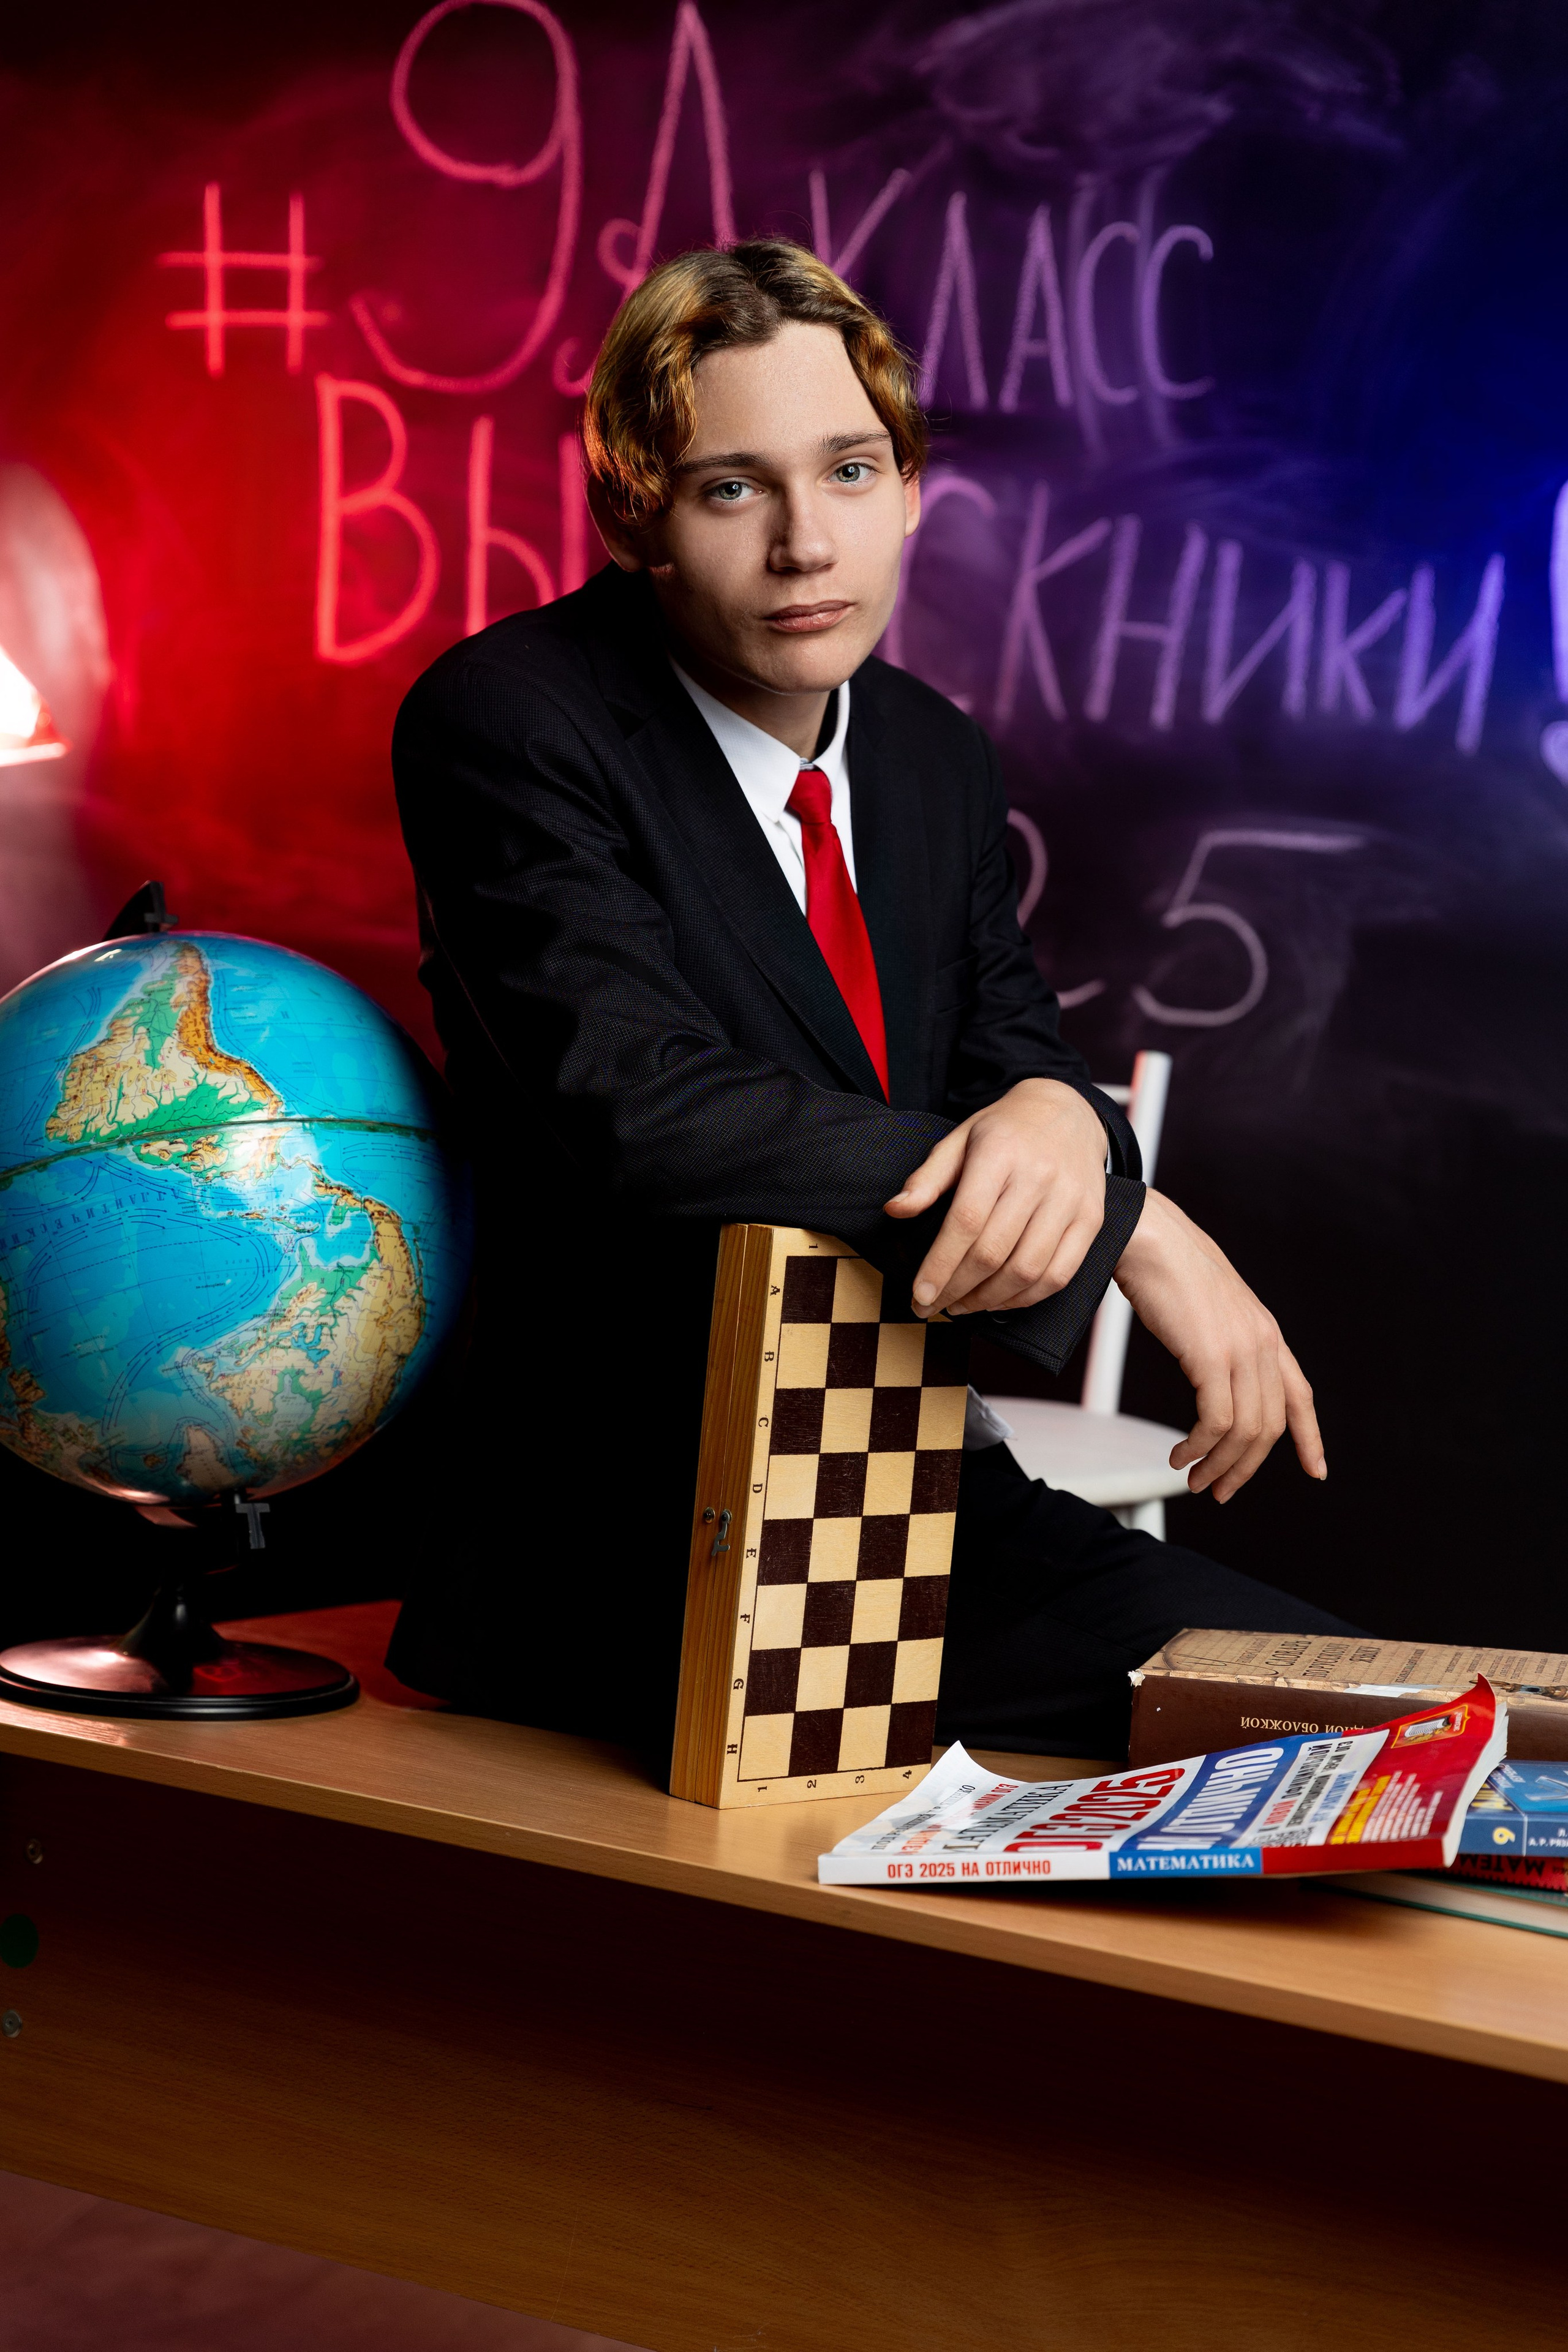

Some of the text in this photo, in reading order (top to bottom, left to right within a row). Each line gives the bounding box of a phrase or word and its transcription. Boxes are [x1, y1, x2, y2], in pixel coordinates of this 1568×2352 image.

[770, 1285, 780, 1296] A
[764, 1351, 775, 1362] B
[758, 1417, 769, 1428] C
[752, 1483, 763, 1494] D
[745, 1548, 757, 1559] E
[740, 1613, 750, 1624] F
[1265, 1640, 1313, 1667] СЛОВАРЬ
[1311, 1643, 1352, 1665] РУССКОМУ
[1349, 1645, 1382, 1664] ЯЗЫКУ
[733, 1678, 744, 1690] G
[1240, 1716, 1319, 1734] ОБЛОЖКОЙ
[726, 1744, 738, 1755] H
[1335, 1741, 1354, 1753] ОГЭ
[855, 1774, 865, 1784] 3
[902, 1770, 912, 1779] 4
[807, 1779, 817, 1789] 2
[990, 1782, 1020, 1794] ОГЭ
[1262, 1798, 1298, 1826] НОВОЙ
[1281, 1743, 1333, 1800] ОФИЦИАЛЬНОЙ
[1161, 1747, 1285, 1835] ОТЛИЧНО
[943, 1782, 1075, 1851] МАТЕМАТИКА
[1117, 1853, 1255, 1872] МАТЕМАТИКА
[1460, 1855, 1546, 1877] МАТЕМ
[888, 1860, 1052, 1879] ОГЭ 2025 НА ОТЛИЧНО
